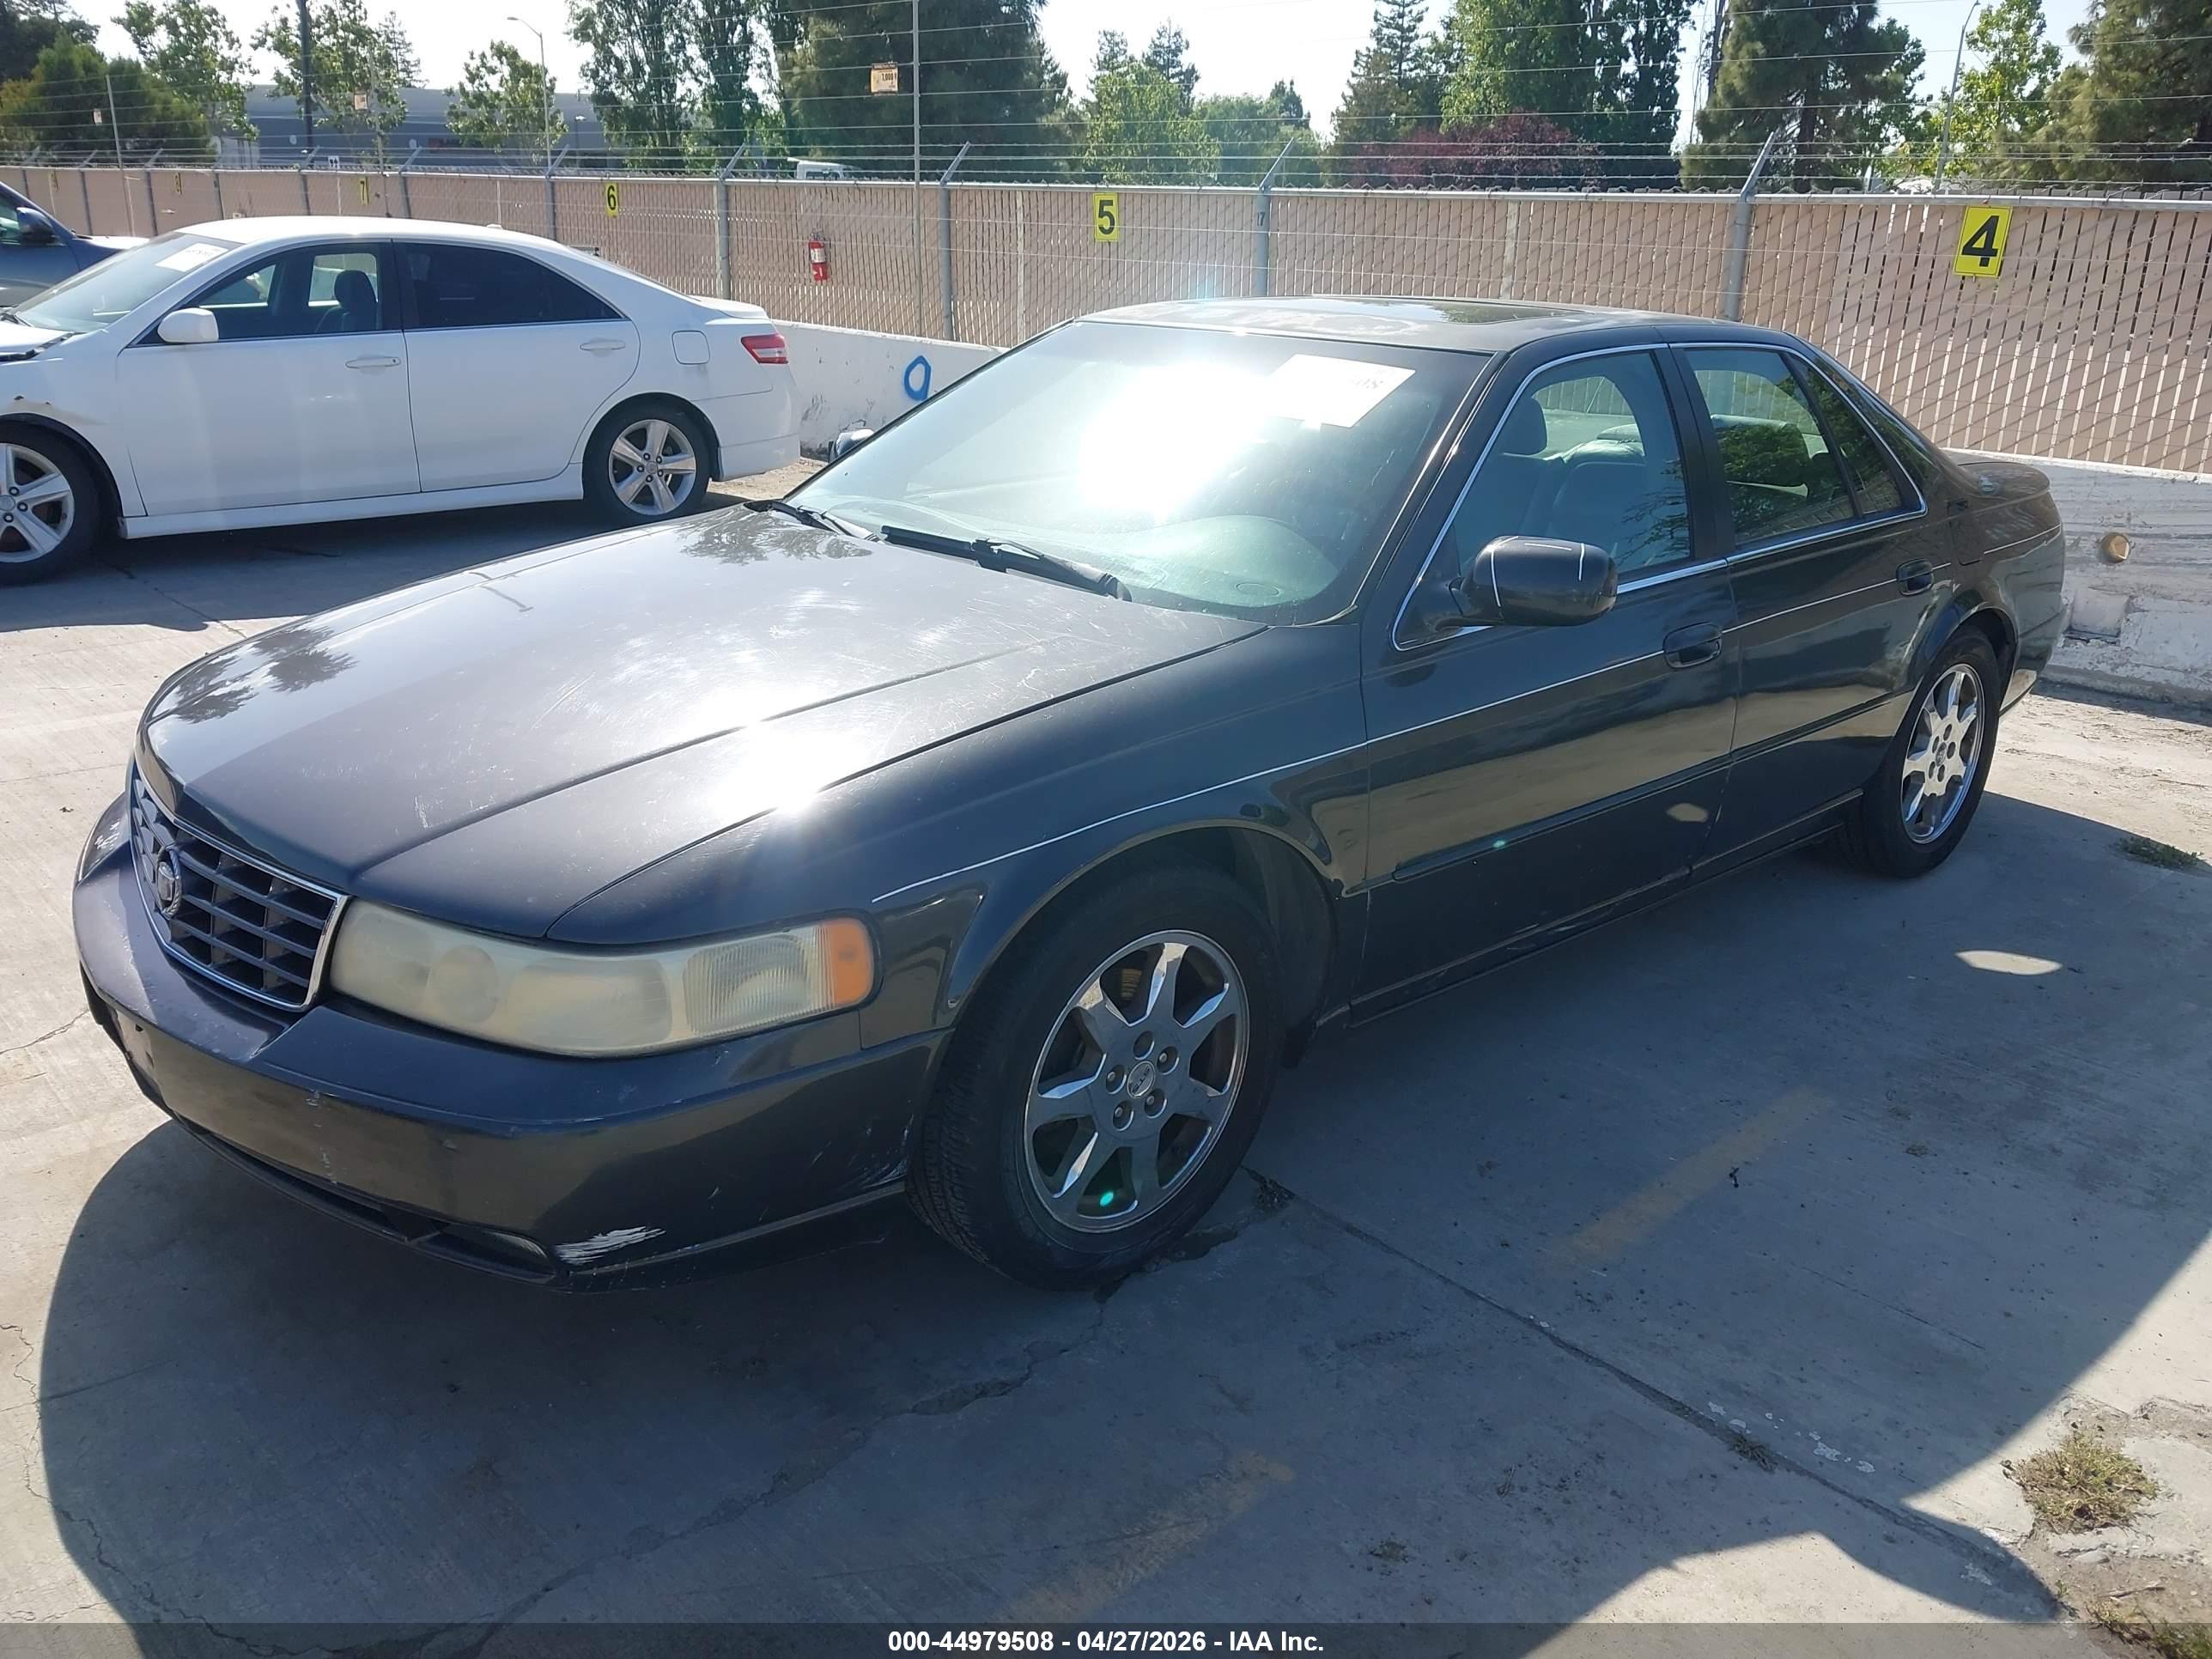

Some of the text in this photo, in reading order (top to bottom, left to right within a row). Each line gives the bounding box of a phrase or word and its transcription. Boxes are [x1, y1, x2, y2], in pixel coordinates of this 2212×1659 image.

[607, 185, 617, 210] 6
[1098, 199, 1115, 235] 5
[1961, 215, 2000, 268] 4
